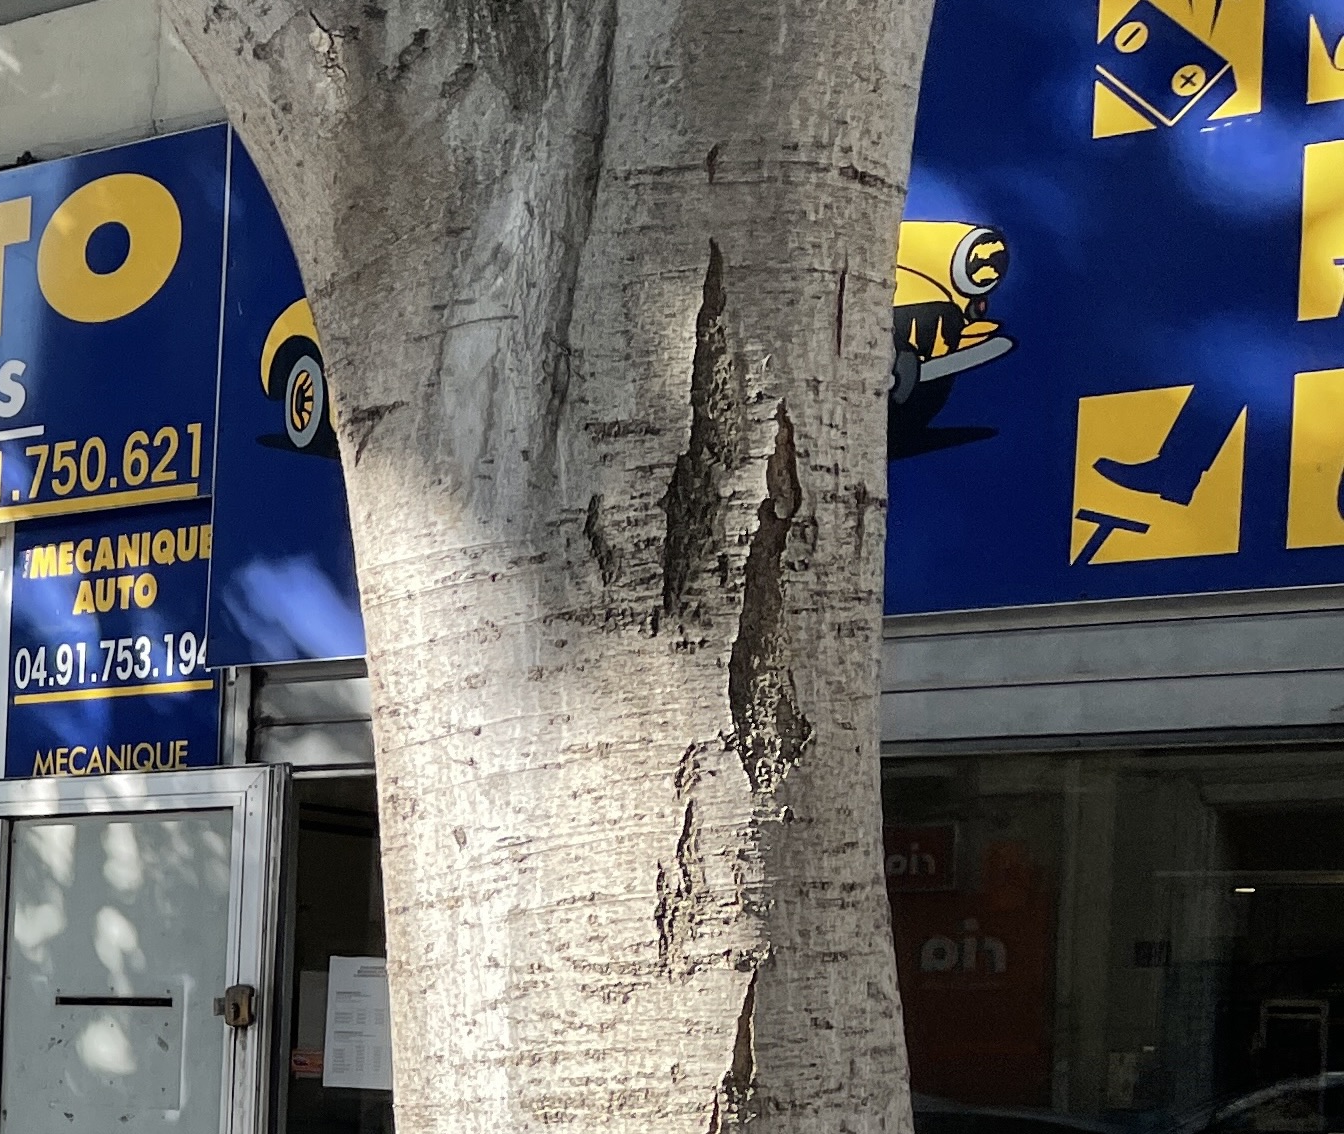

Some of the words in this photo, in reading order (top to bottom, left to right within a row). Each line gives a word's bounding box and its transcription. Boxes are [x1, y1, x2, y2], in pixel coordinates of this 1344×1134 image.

[30, 525, 212, 579] MECANIQUE
[73, 573, 158, 615] AUTO
[32, 740, 189, 777] MECANIQUE
